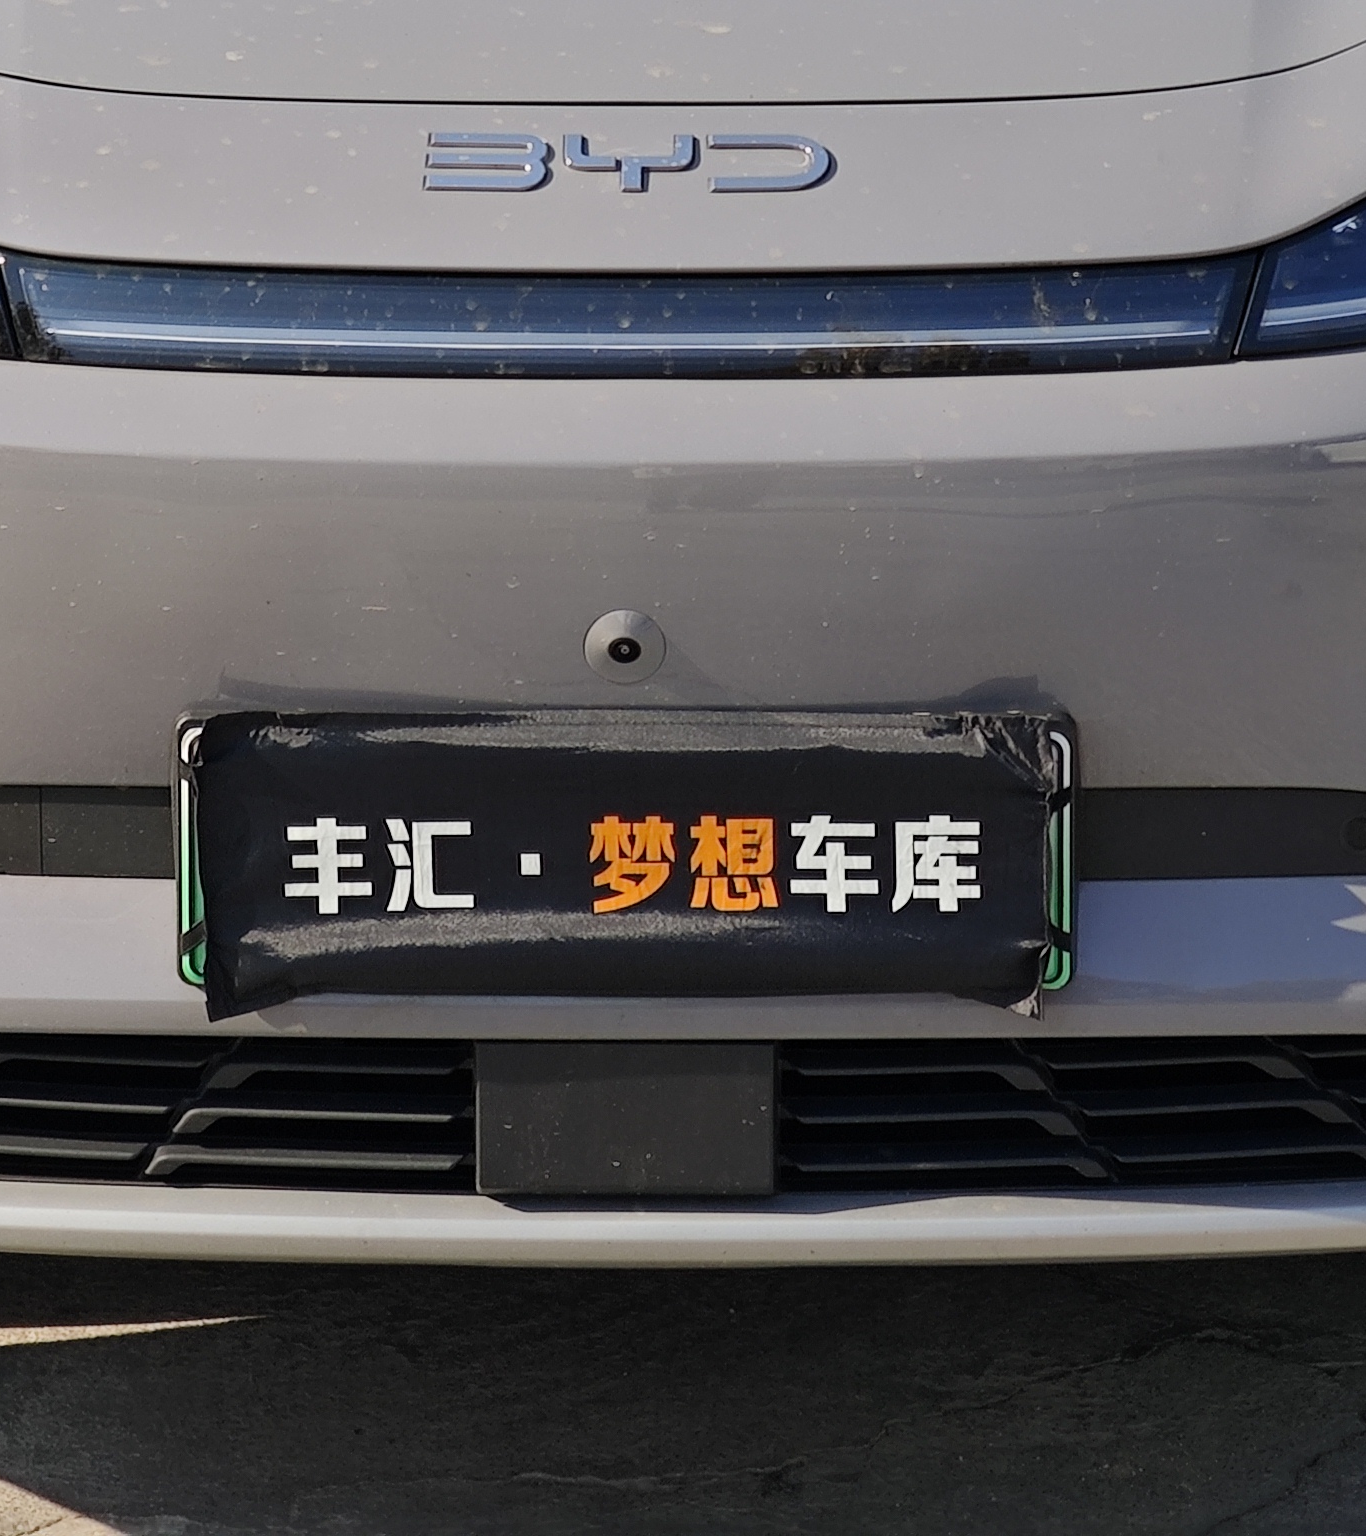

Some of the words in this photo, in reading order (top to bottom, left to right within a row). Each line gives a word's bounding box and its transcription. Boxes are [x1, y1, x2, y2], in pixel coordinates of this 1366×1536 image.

[424, 133, 835, 193] BYD
[283, 815, 983, 915] 丰汇·梦想车库
